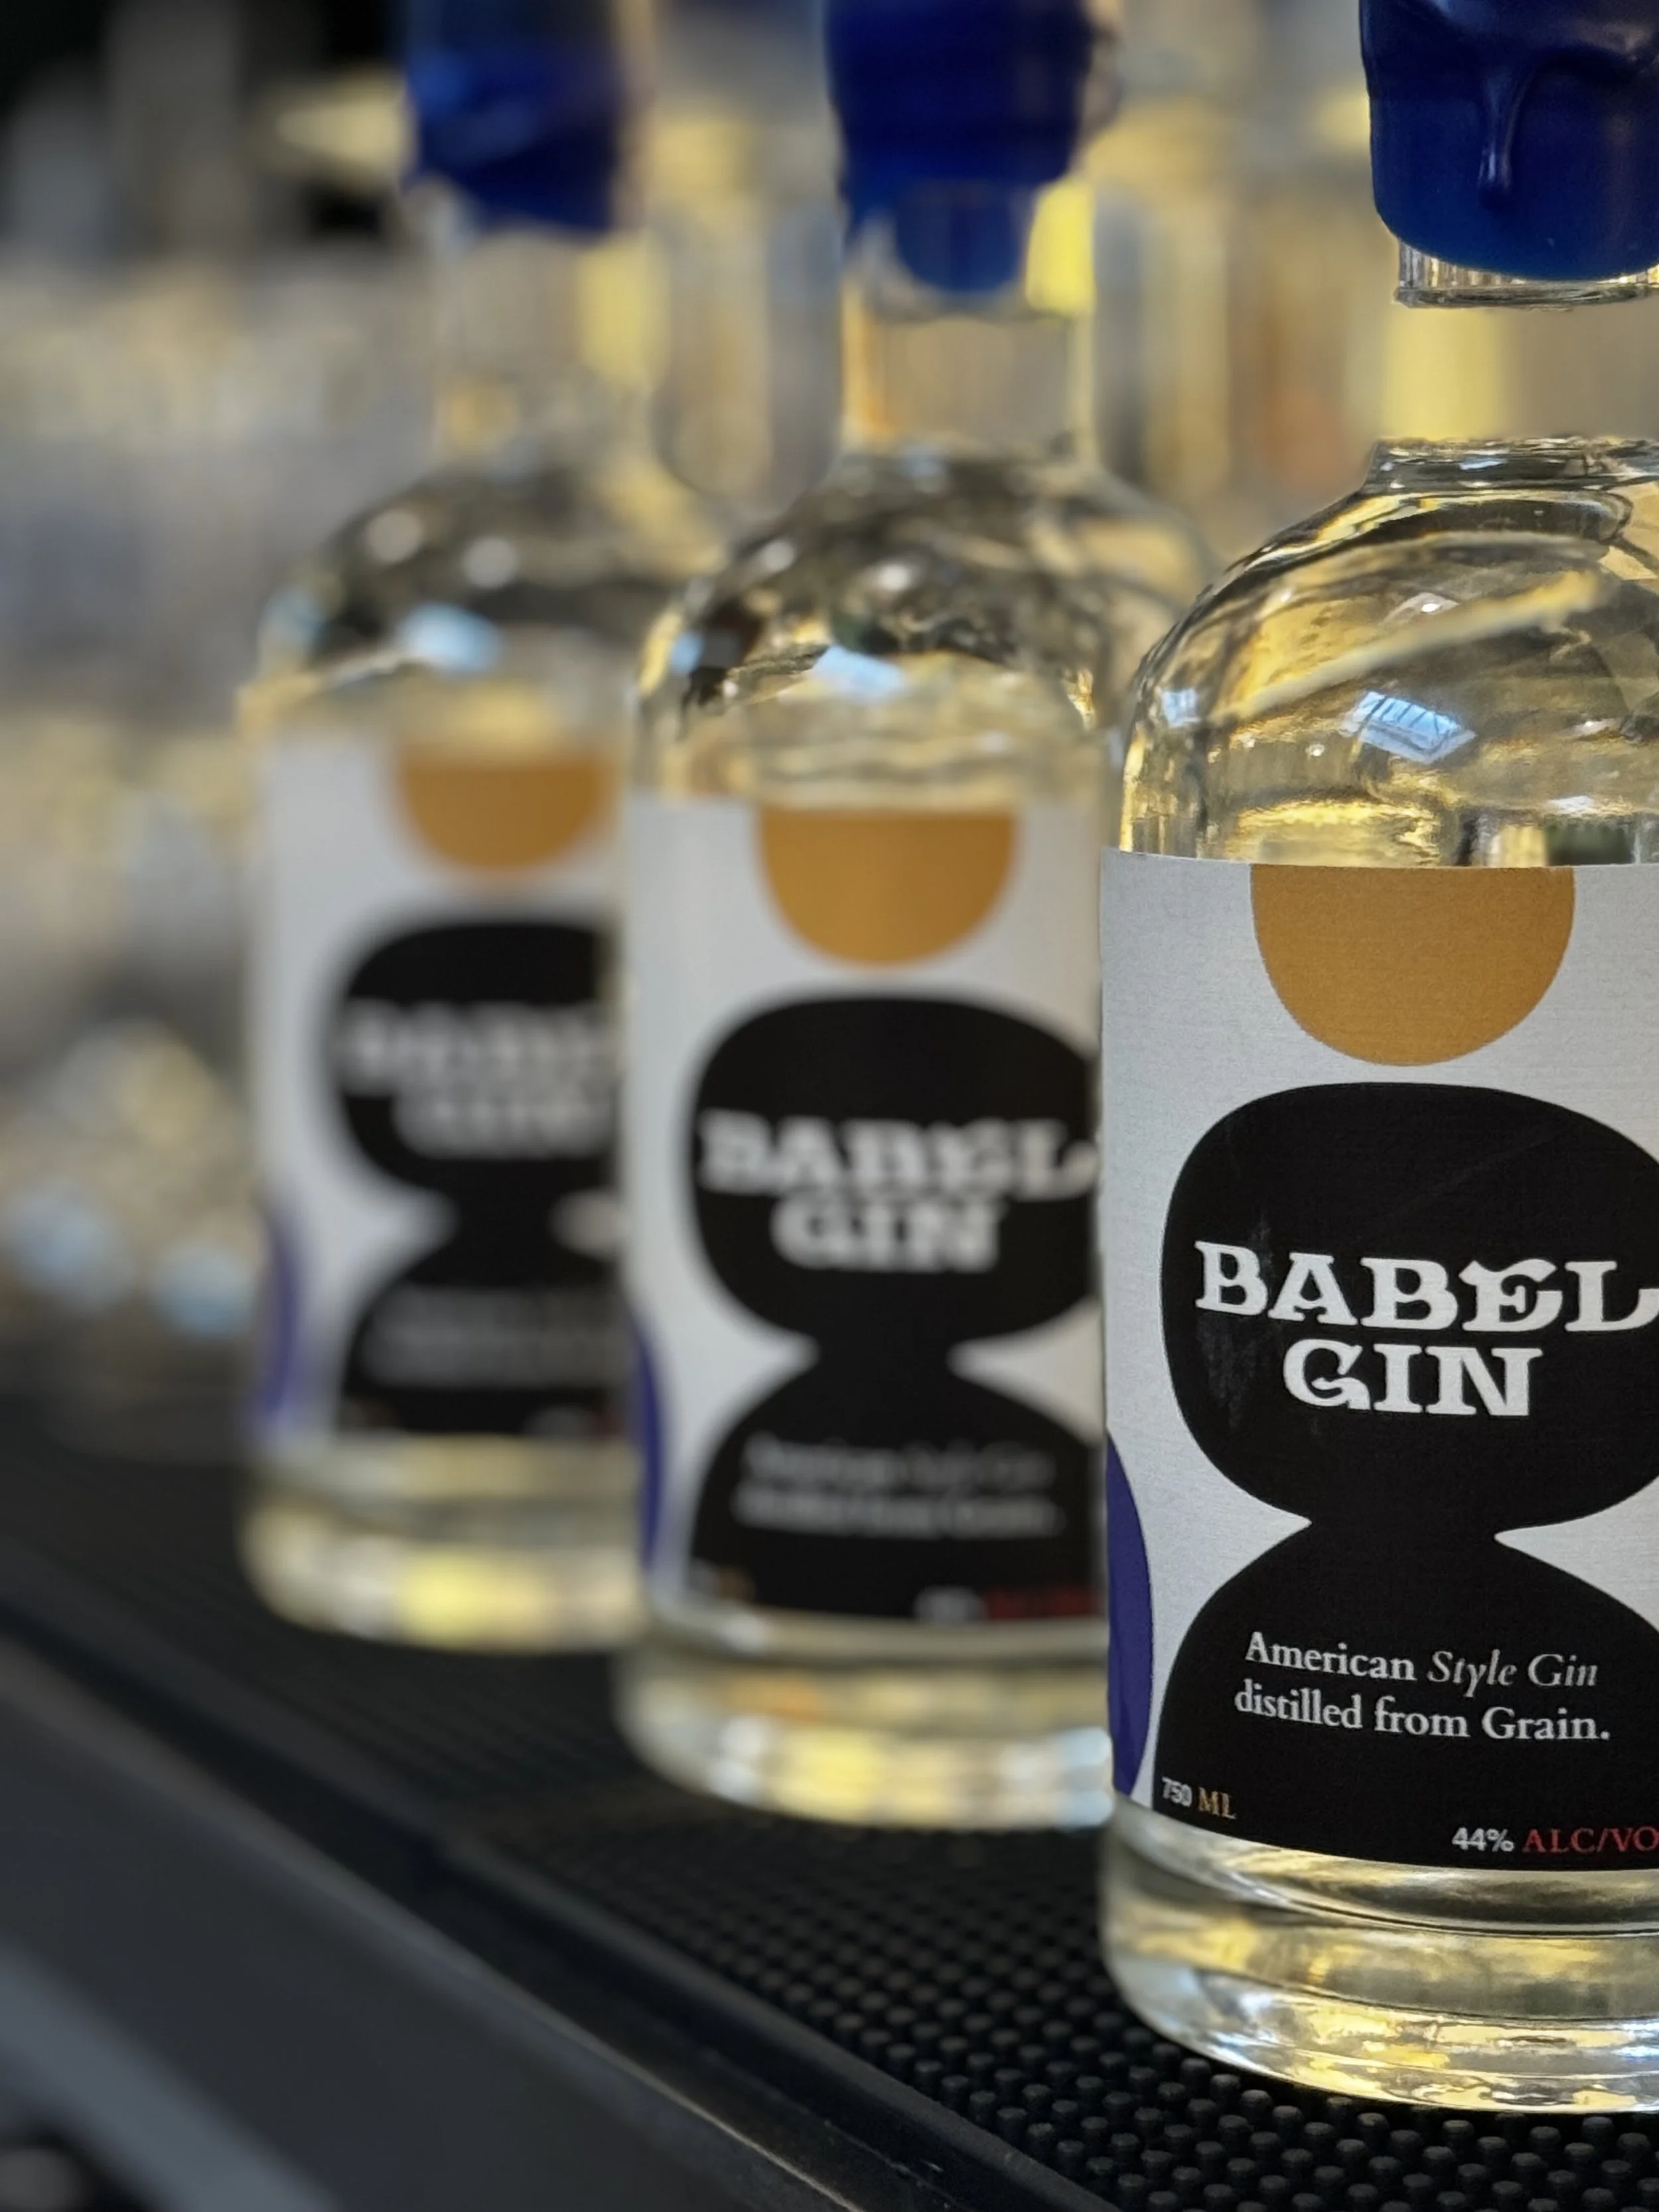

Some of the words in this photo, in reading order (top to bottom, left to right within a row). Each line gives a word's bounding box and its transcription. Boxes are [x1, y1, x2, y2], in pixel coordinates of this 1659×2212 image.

[698, 1109, 1098, 1200] BABEL
[770, 1197, 1003, 1273] GIN
[1194, 1240, 1659, 1332] BABEL
[1283, 1339, 1543, 1416] GIN
[1245, 1631, 1417, 1681] American
[1427, 1650, 1517, 1697] Style
[1528, 1654, 1598, 1686] Gin
[1234, 1680, 1362, 1729] distilled
[1374, 1697, 1471, 1737] from
[1482, 1707, 1611, 1740] Grain.
[1162, 1777, 1192, 1806] 750
[1198, 1787, 1236, 1819] ML
[1451, 1827, 1515, 1852] 44%
